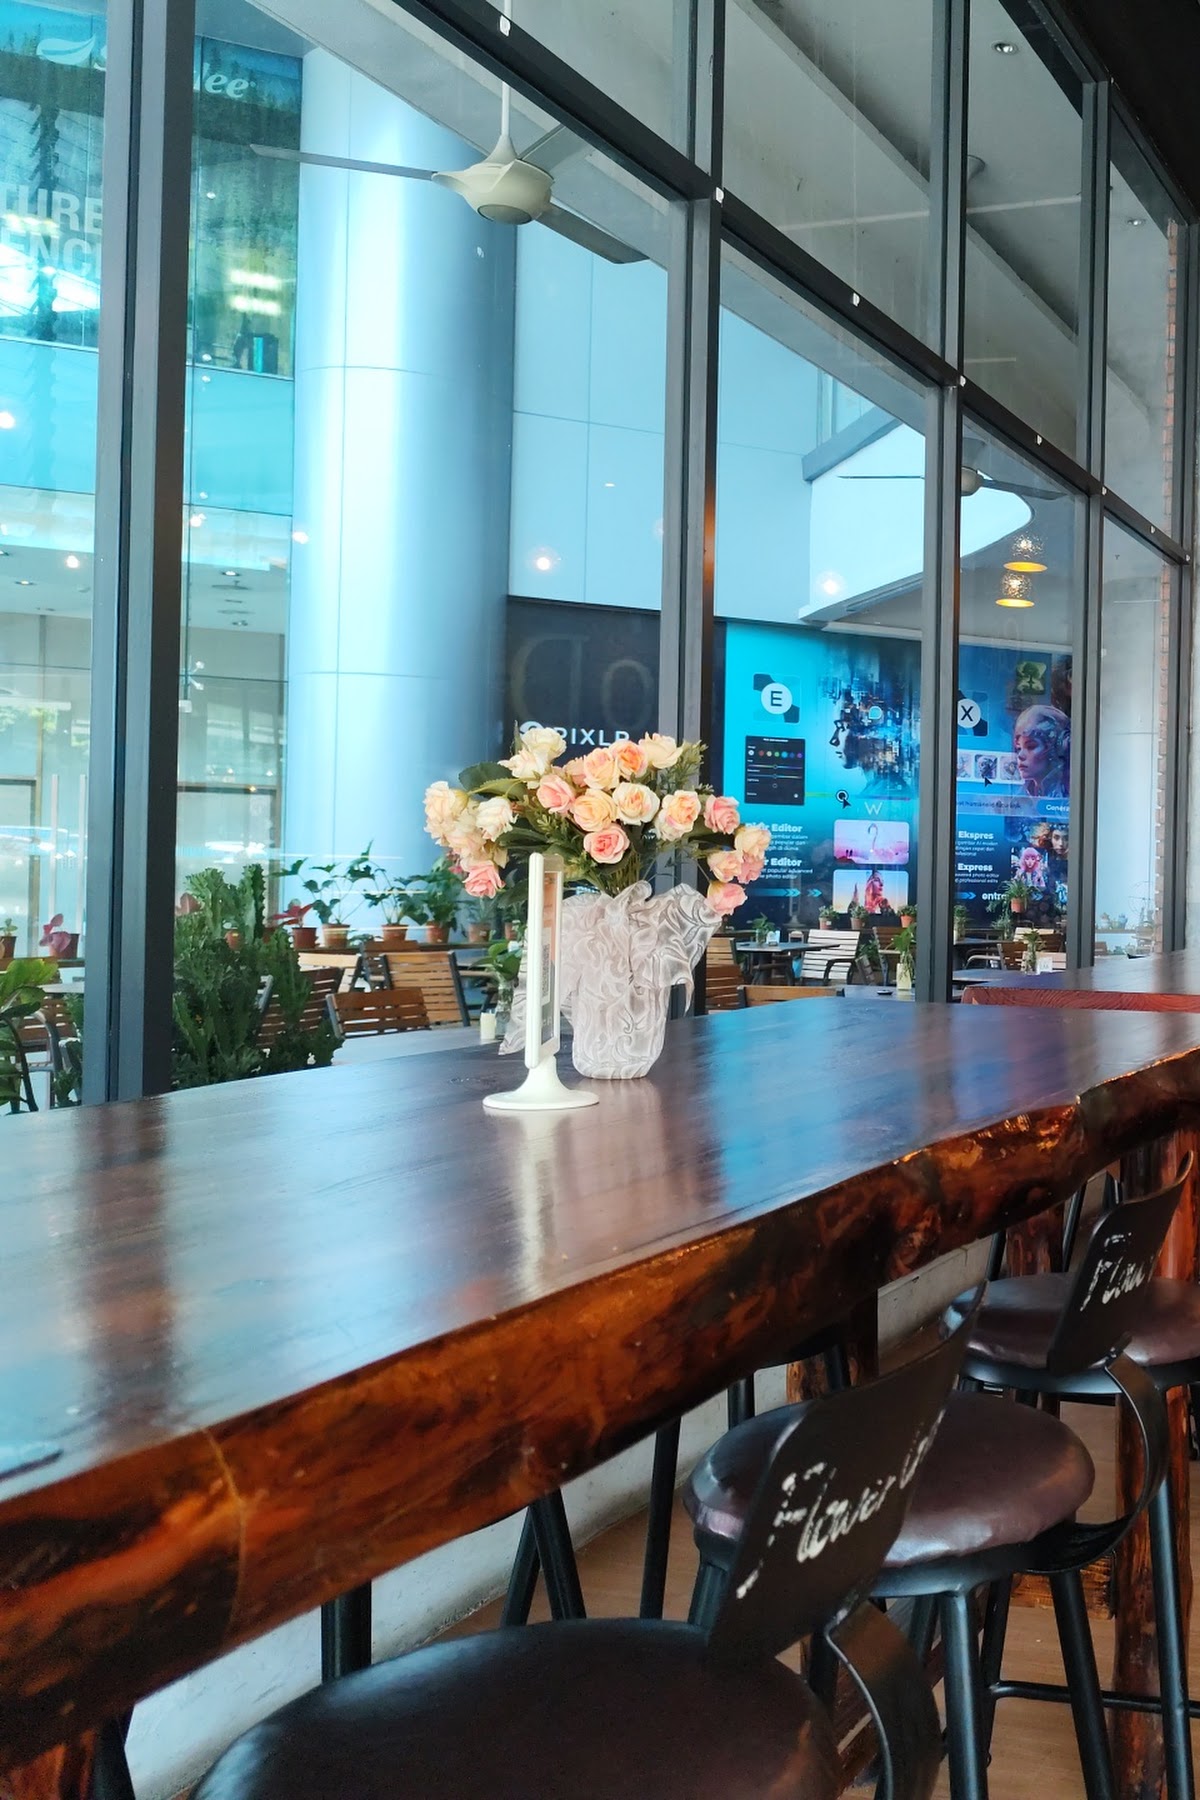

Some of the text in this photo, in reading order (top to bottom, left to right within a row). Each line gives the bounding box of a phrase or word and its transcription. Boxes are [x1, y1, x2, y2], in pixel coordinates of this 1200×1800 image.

[770, 690, 783, 707] E
[960, 704, 974, 722] X
[771, 823, 803, 832] Editor
[958, 830, 994, 840] Ekspres
[770, 857, 802, 867] Editor
[957, 863, 993, 873] Express
